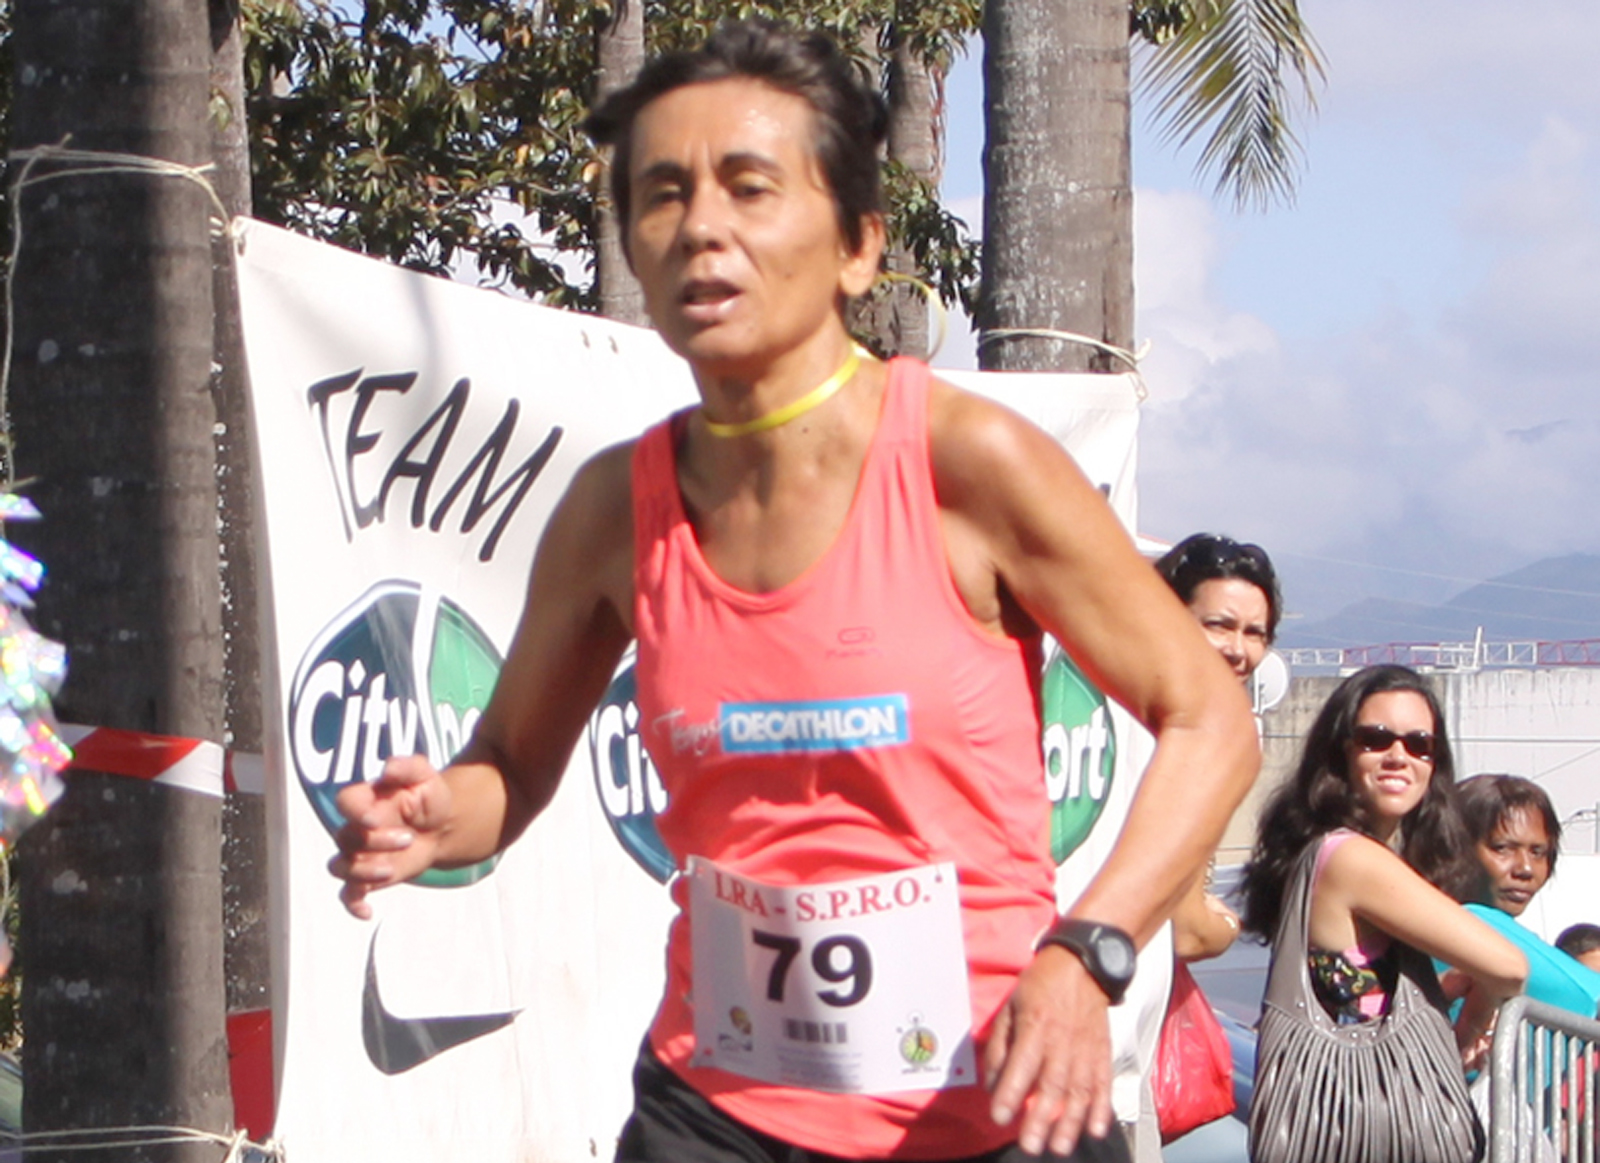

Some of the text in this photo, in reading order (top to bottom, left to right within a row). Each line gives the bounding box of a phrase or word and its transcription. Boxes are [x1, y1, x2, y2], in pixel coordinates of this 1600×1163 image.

[307, 366, 564, 562] TEAM
[596, 700, 668, 817] Cit
[731, 705, 898, 743] DECATHLON
[1043, 705, 1107, 802] ort
[796, 876, 932, 923] S.P.R.O.
[752, 928, 873, 1009] 79
